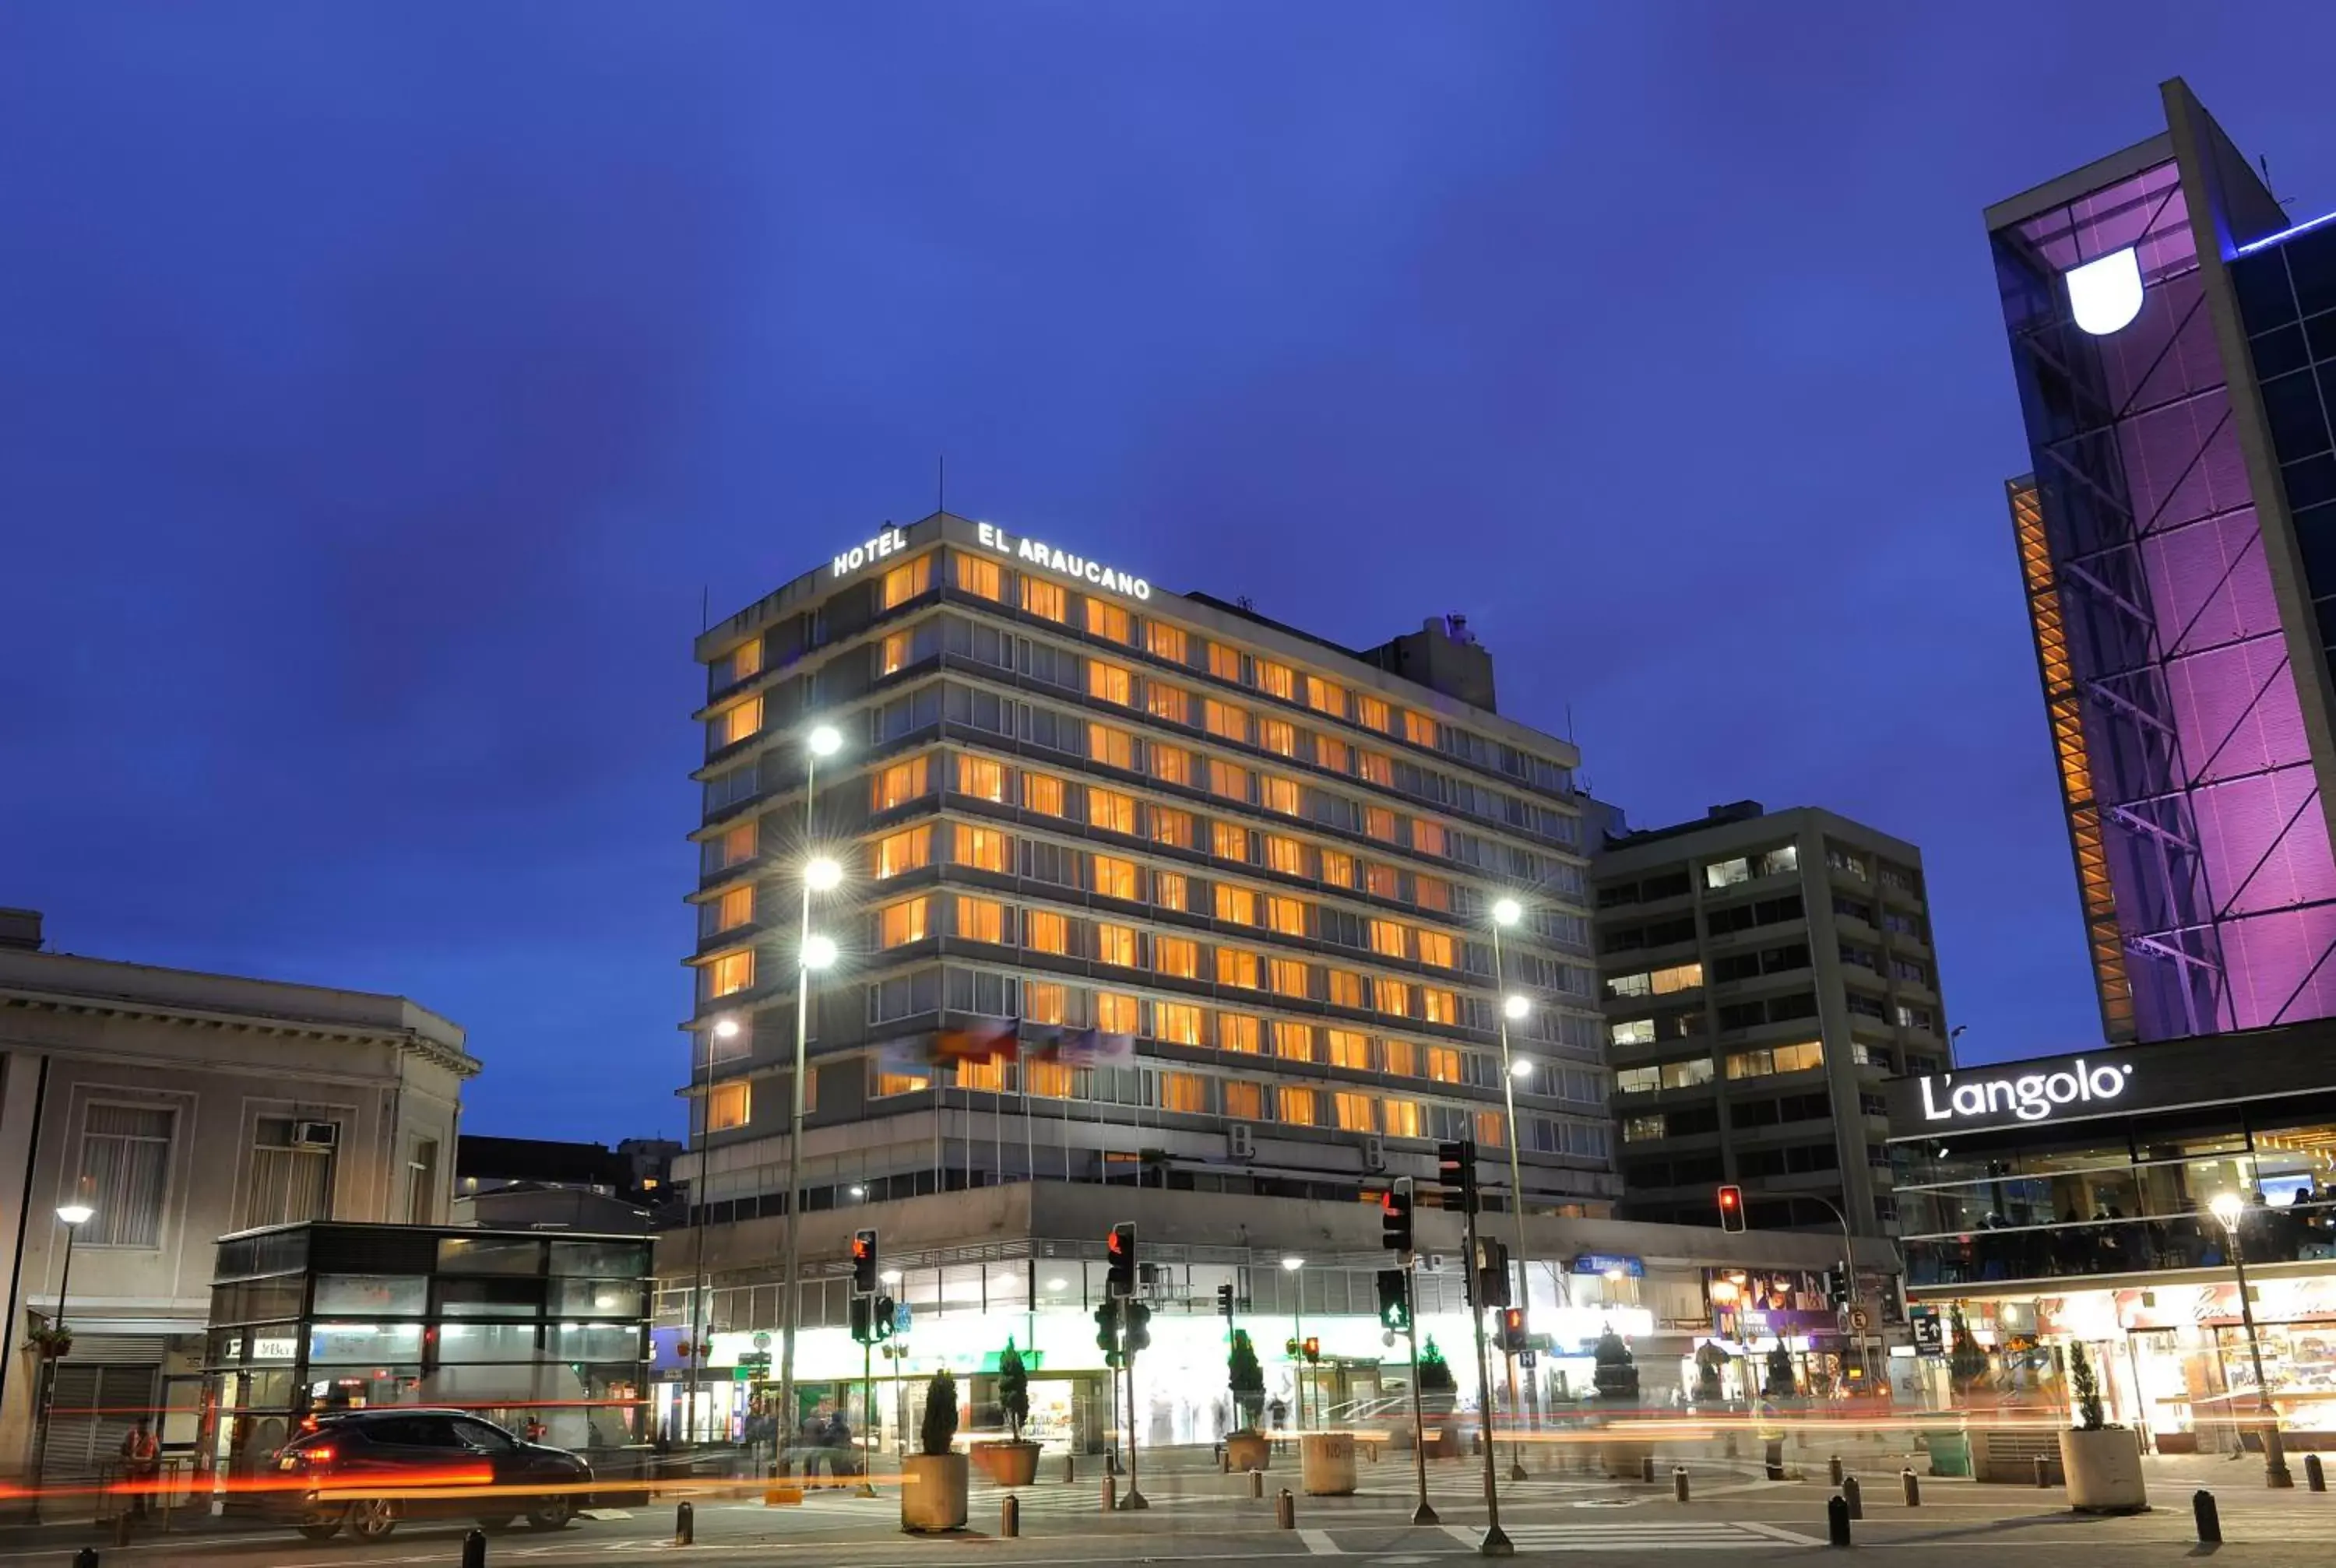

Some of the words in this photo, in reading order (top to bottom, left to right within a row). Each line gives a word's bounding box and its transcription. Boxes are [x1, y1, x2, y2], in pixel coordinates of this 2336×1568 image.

[832, 529, 906, 578] HOTEL
[978, 522, 1010, 553] EL
[1018, 537, 1151, 600] ARAUCANO
[1919, 1059, 2125, 1120] L'angolo
[1914, 1318, 1929, 1341] E
[1522, 1353, 1534, 1365] H
